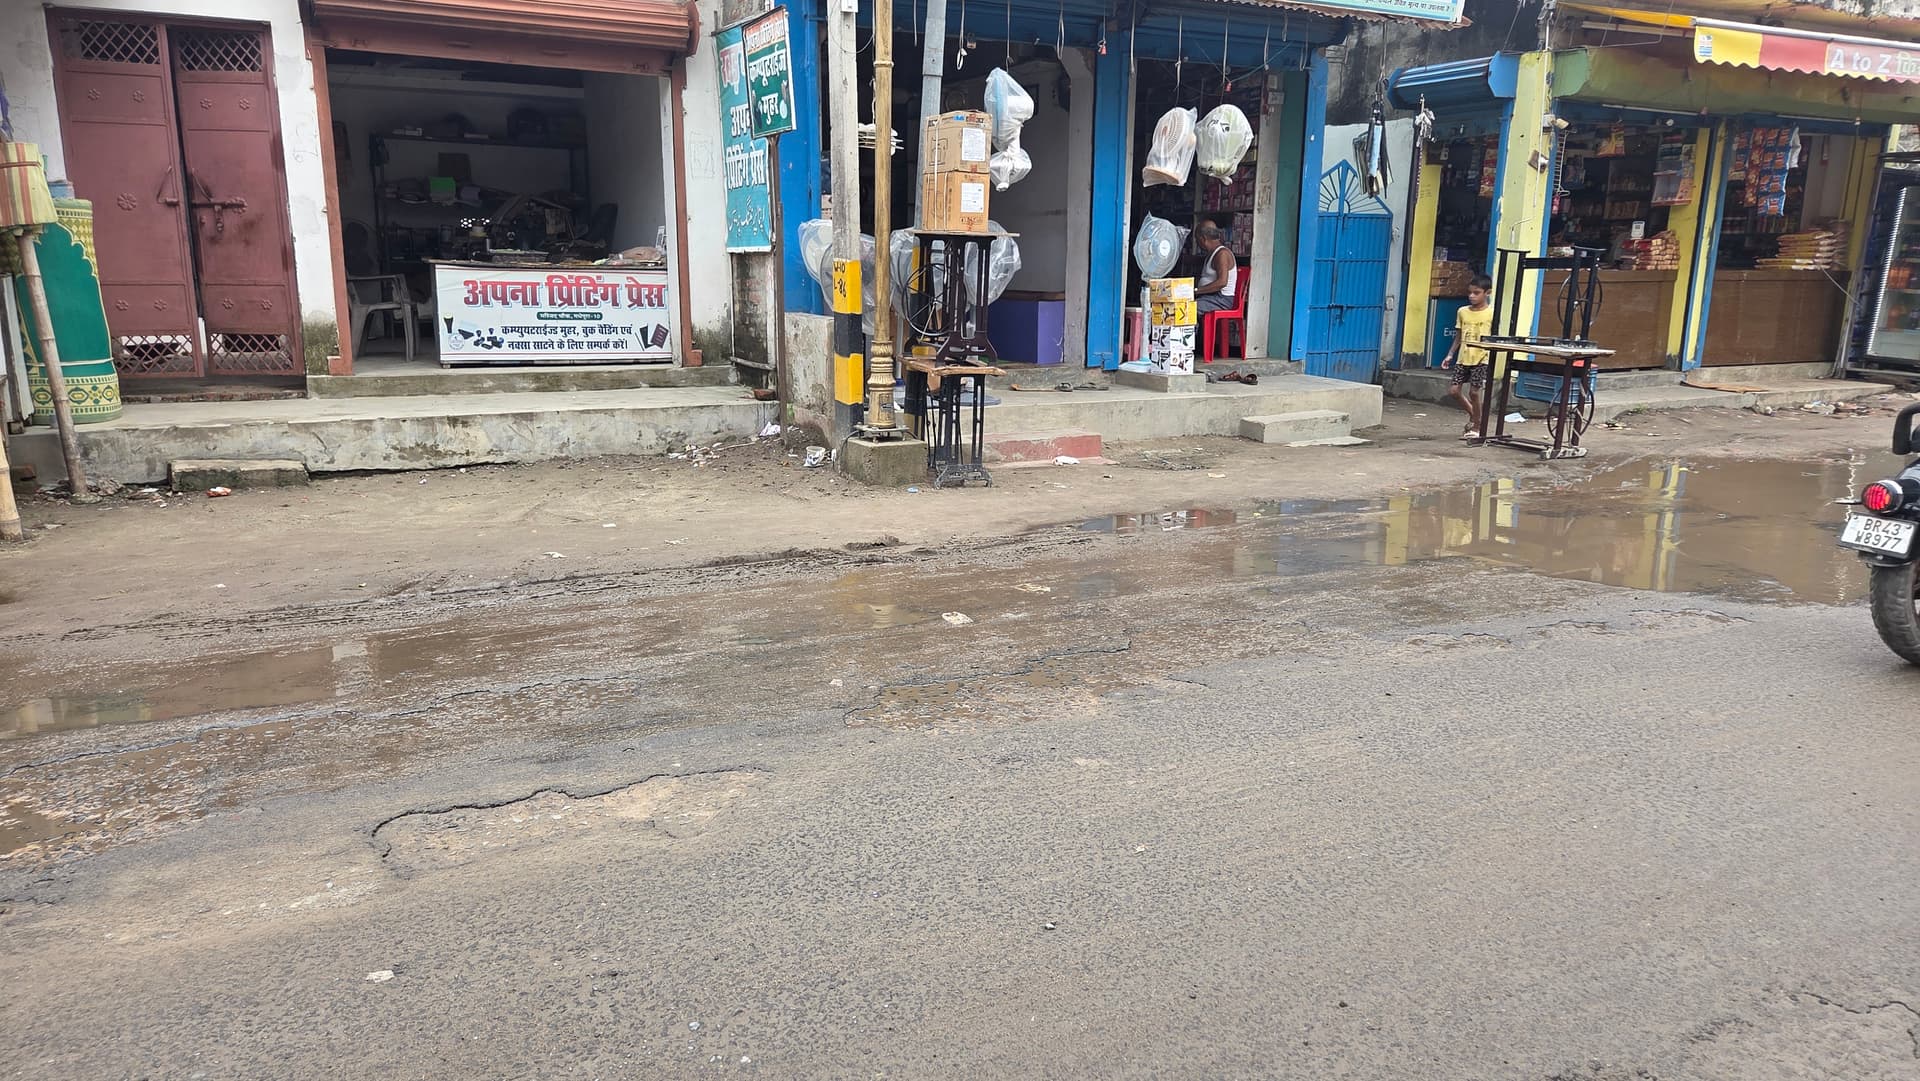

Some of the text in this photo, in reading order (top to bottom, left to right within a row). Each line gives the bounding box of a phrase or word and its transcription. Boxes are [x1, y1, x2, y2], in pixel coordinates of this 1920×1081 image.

[1830, 48, 1846, 69] A
[1852, 52, 1871, 71] to
[1877, 54, 1892, 74] Z
[463, 275, 668, 310] अपना प्रिंटिंग प्रेस
[620, 324, 633, 335] एवं
[557, 338, 565, 350] के
[567, 338, 584, 350] लिए
